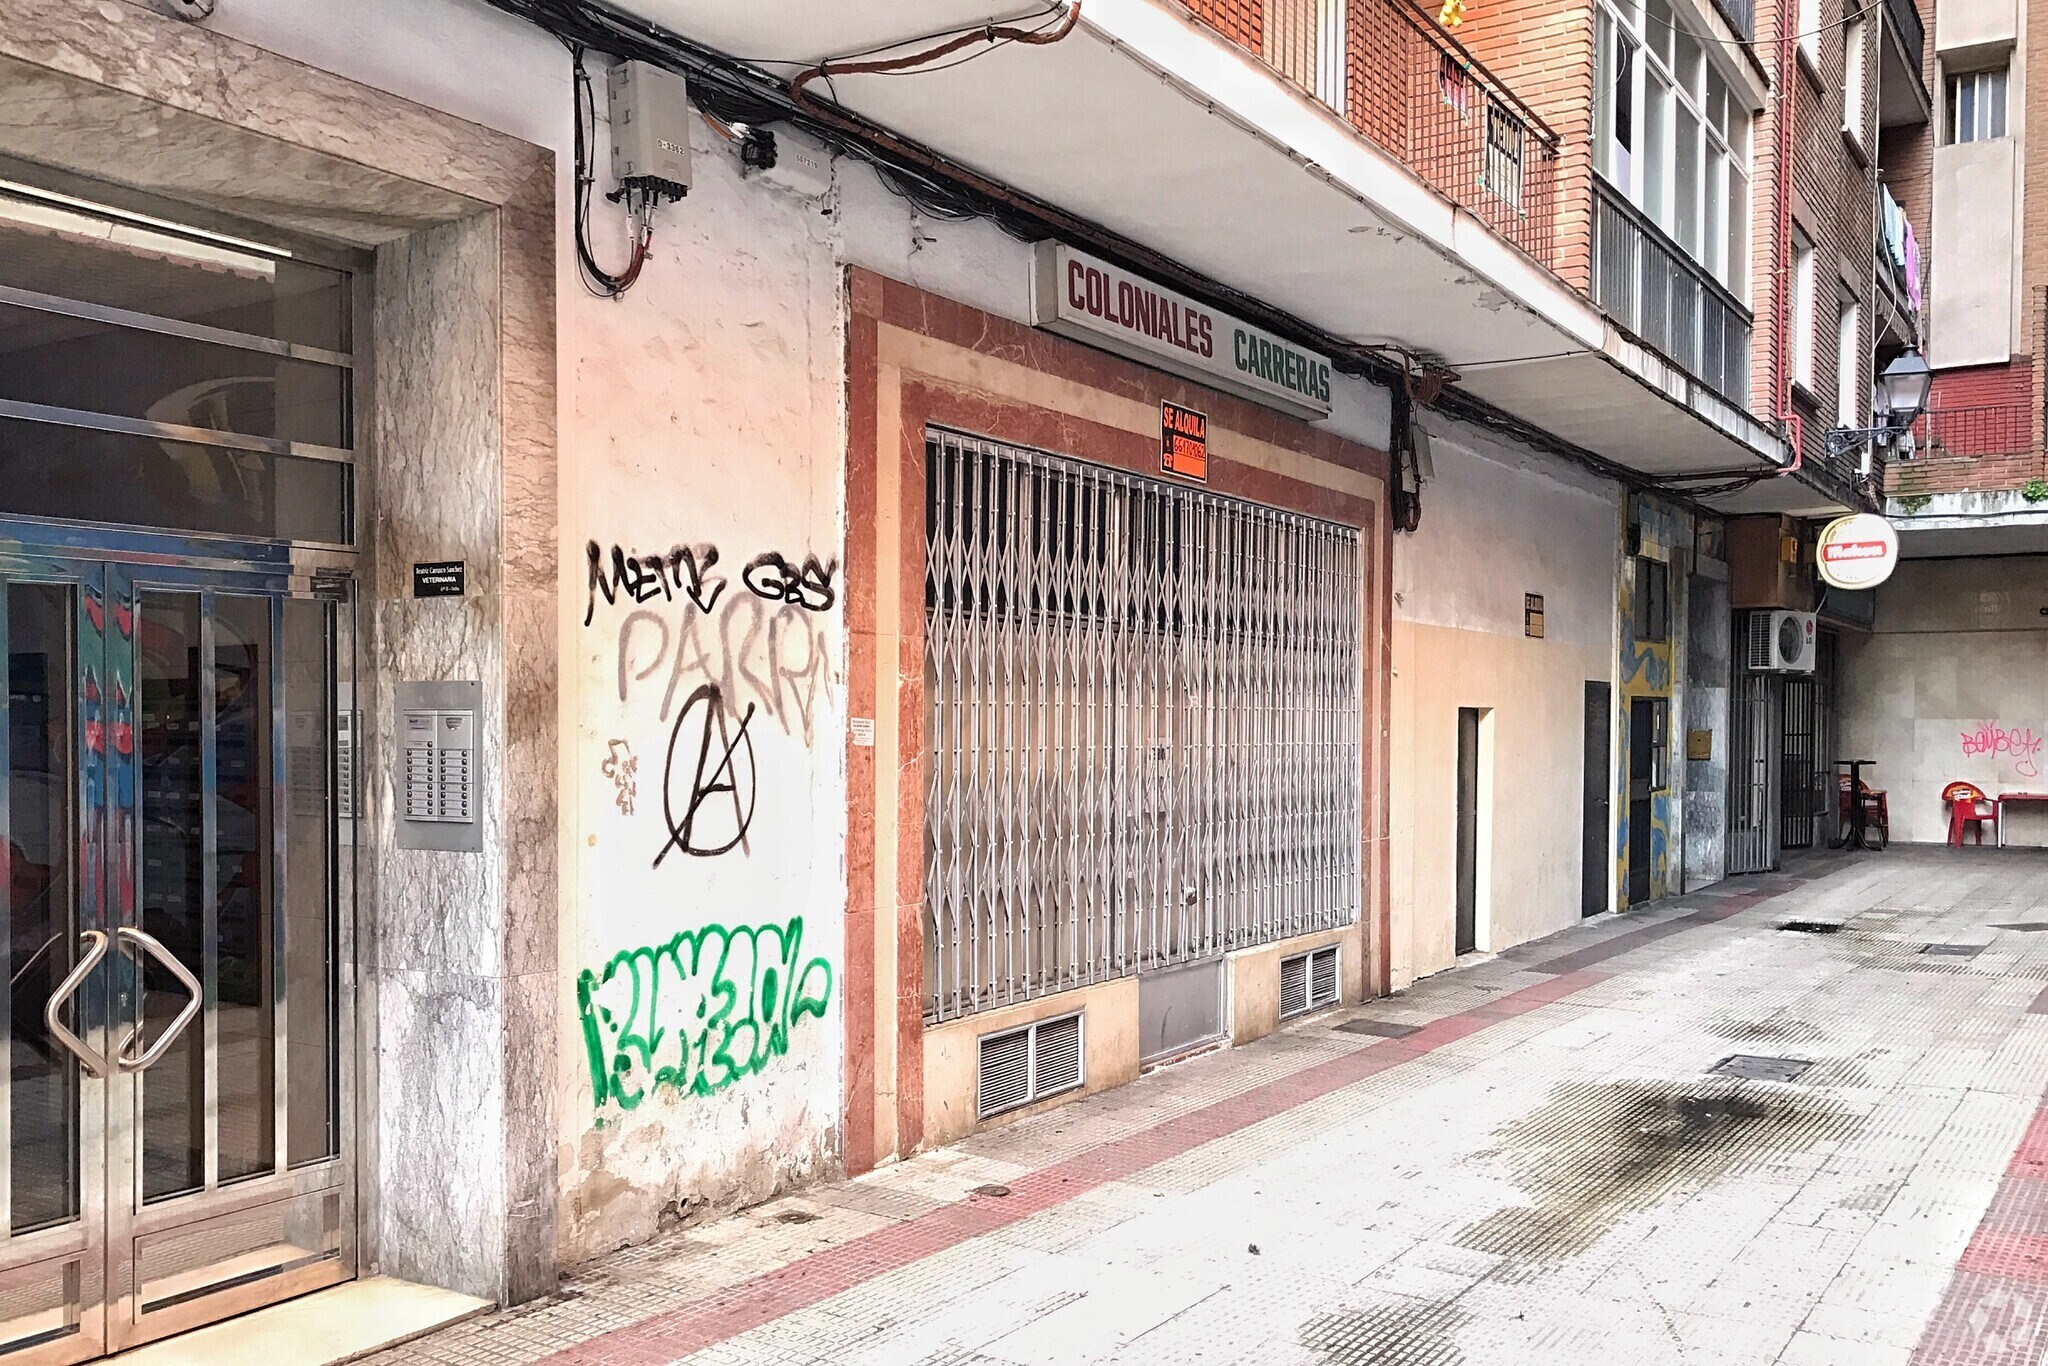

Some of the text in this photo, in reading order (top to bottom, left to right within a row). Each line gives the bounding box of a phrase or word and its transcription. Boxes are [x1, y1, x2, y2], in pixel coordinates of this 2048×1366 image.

[1068, 259, 1330, 403] COLONIALES CARRERAS
[1163, 406, 1205, 439] SE ALQUILA
[422, 576, 457, 584] VETERINARIA
